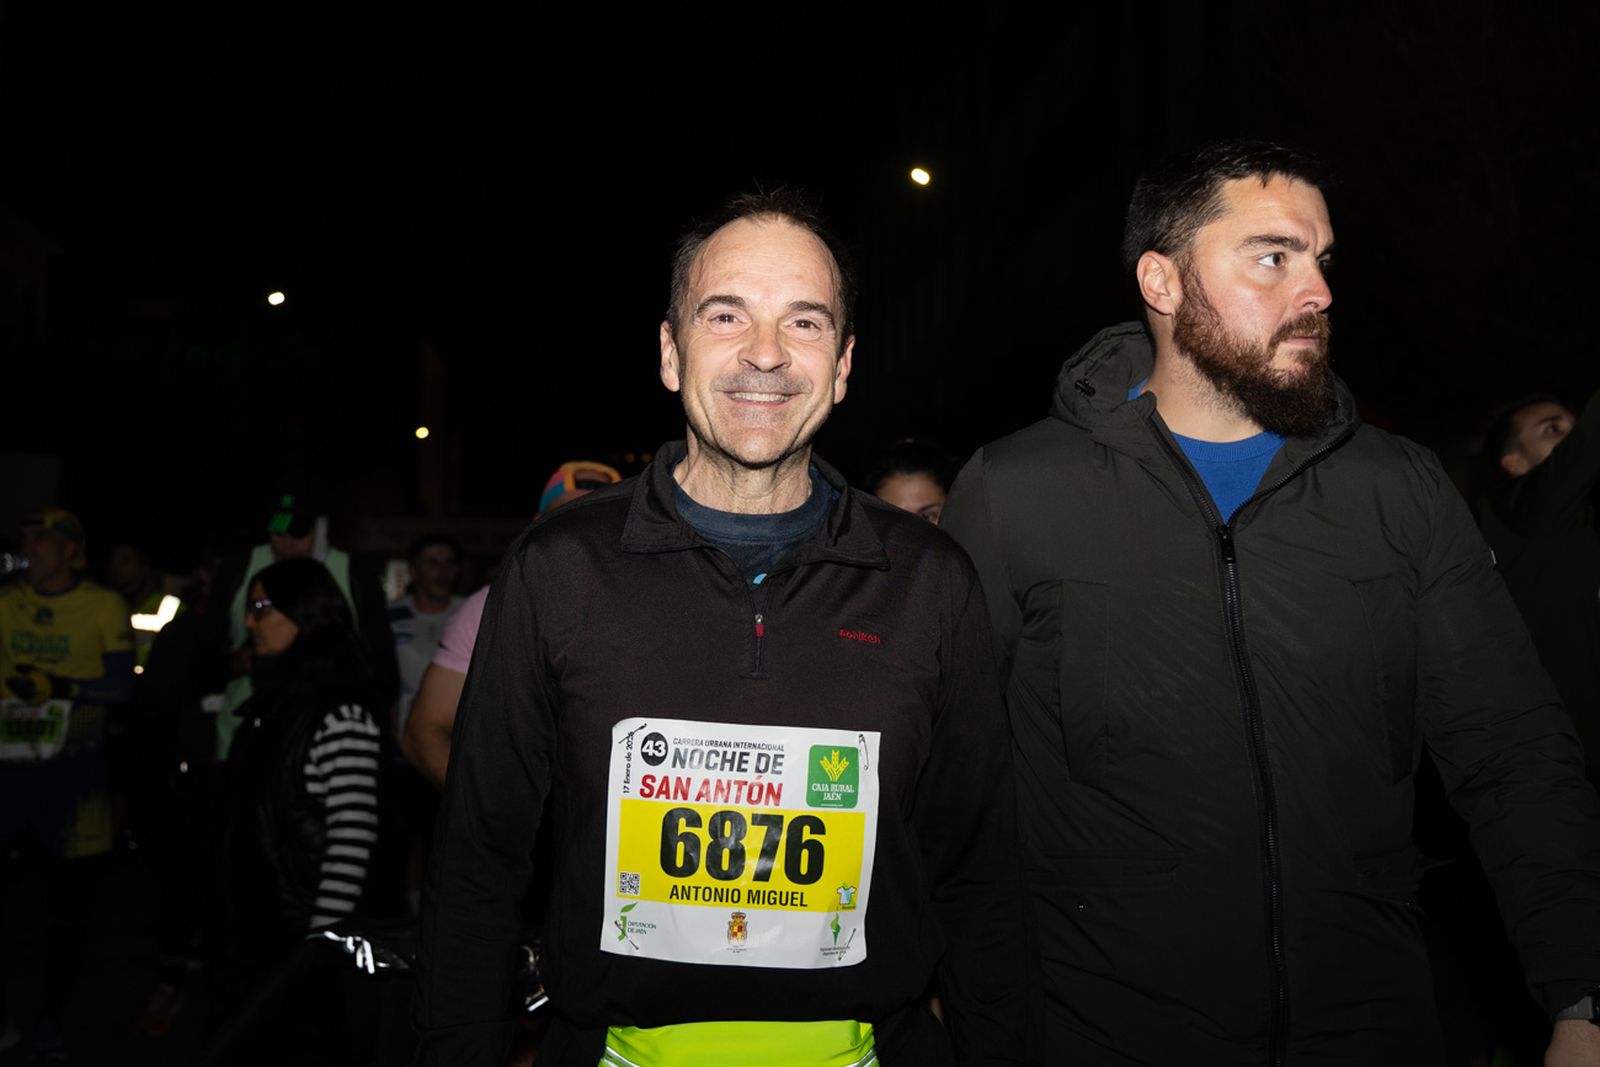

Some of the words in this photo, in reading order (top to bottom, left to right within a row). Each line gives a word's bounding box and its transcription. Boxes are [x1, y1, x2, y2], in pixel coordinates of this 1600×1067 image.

[642, 740, 667, 757] 43
[673, 737, 703, 747] CARRERA
[704, 739, 732, 748] URBANA
[732, 741, 784, 752] INTERNACIONAL
[625, 752, 632, 762] de
[671, 747, 750, 773] NOCHE
[755, 752, 785, 775] DE
[624, 762, 632, 784] Enero
[623, 785, 630, 794] 17
[639, 774, 692, 801] SAN
[695, 775, 784, 807] ANTÓN
[811, 783, 829, 792] CAJA
[830, 783, 854, 793] RURAL
[659, 807, 826, 885] 6876
[669, 884, 741, 904] ANTONIO
[747, 889, 808, 907] MIGUEL
